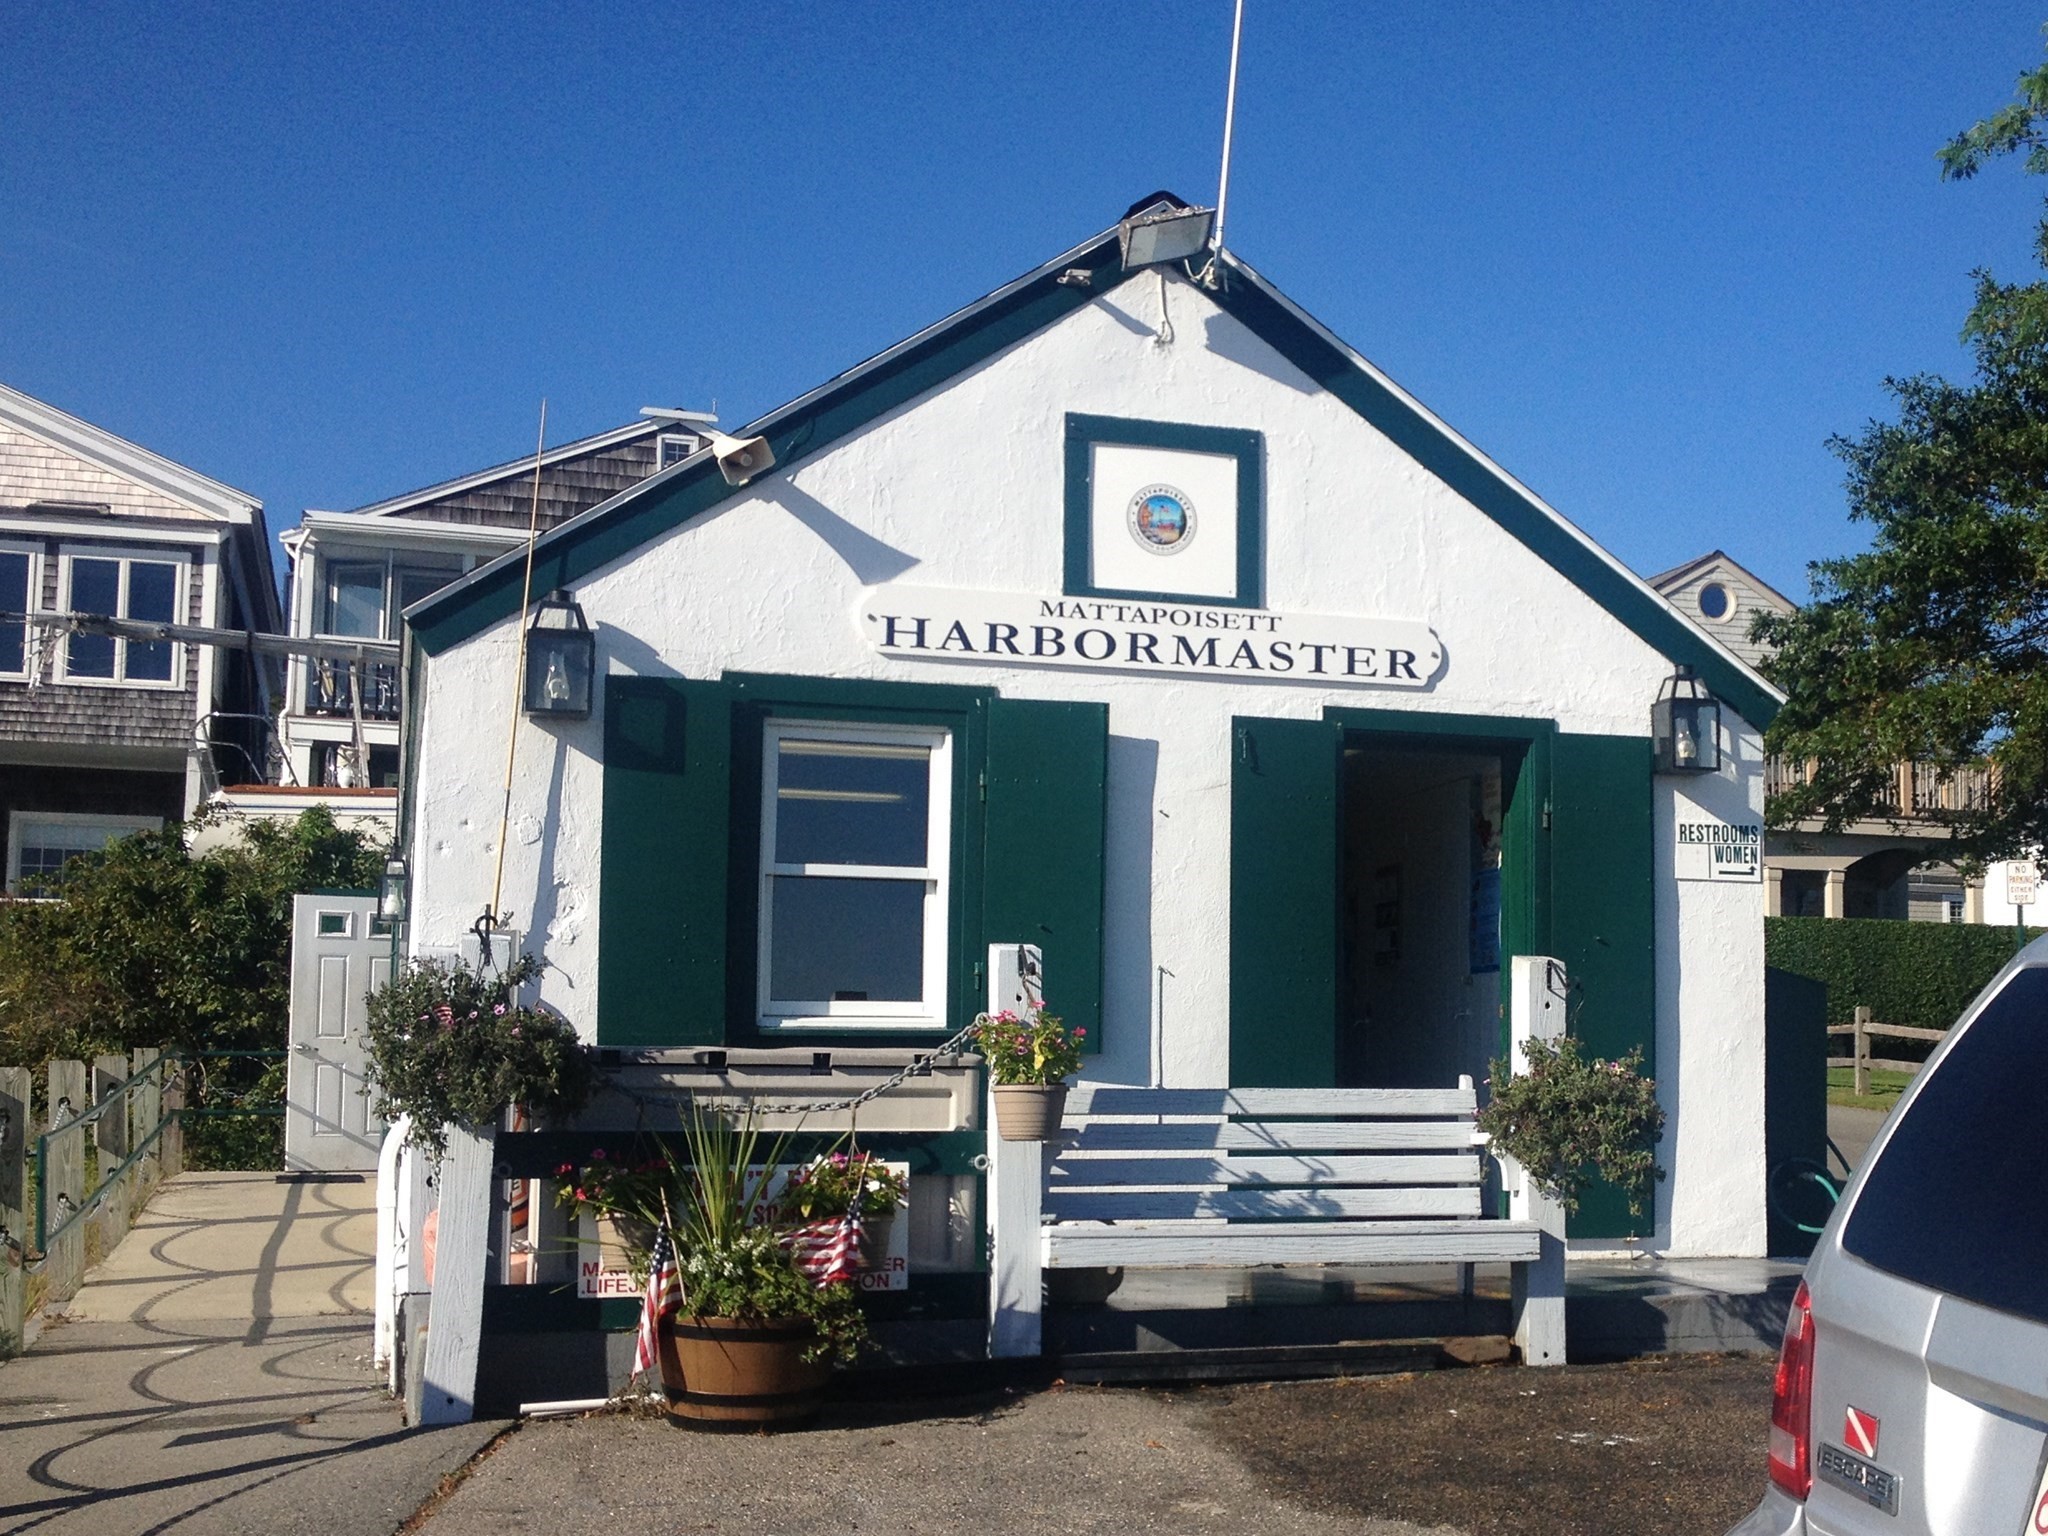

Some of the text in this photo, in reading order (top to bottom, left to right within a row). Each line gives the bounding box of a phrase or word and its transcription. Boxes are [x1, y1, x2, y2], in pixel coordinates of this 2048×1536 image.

[1039, 599, 1283, 633] MATTAPOISETT
[878, 613, 1423, 681] HARBORMASTER
[1678, 823, 1759, 843] RESTROOMS
[1714, 845, 1758, 864] WOMEN
[2008, 875, 2033, 884] PARKING
[2014, 865, 2026, 874] NO
[1822, 1451, 1889, 1498] ESCAPE
